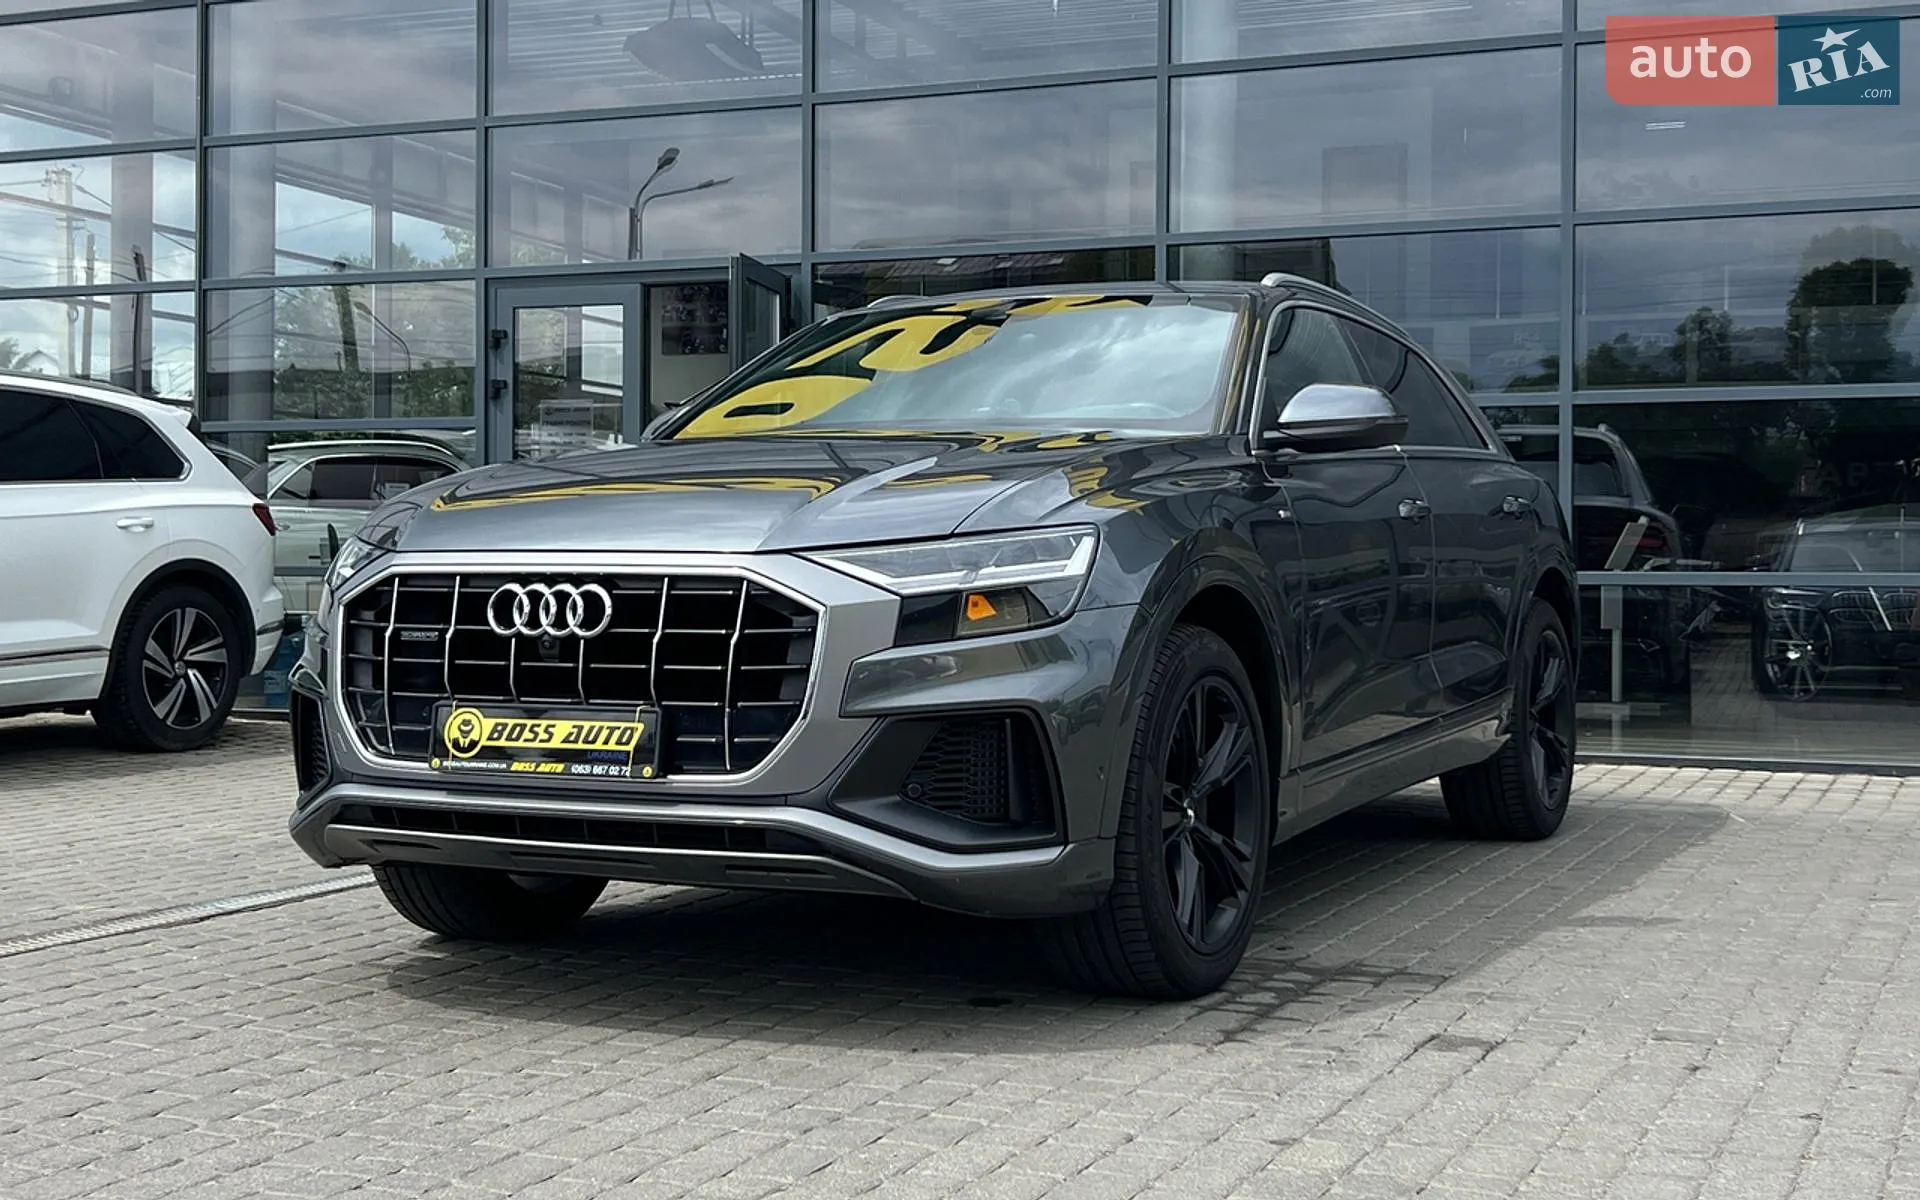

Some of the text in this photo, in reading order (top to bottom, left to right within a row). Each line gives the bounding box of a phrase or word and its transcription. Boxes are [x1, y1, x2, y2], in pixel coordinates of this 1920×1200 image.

[486, 722, 638, 746] BOSS AUTO
[588, 750, 628, 760] UKRAINE
[510, 762, 565, 773] BOSS AUTO
